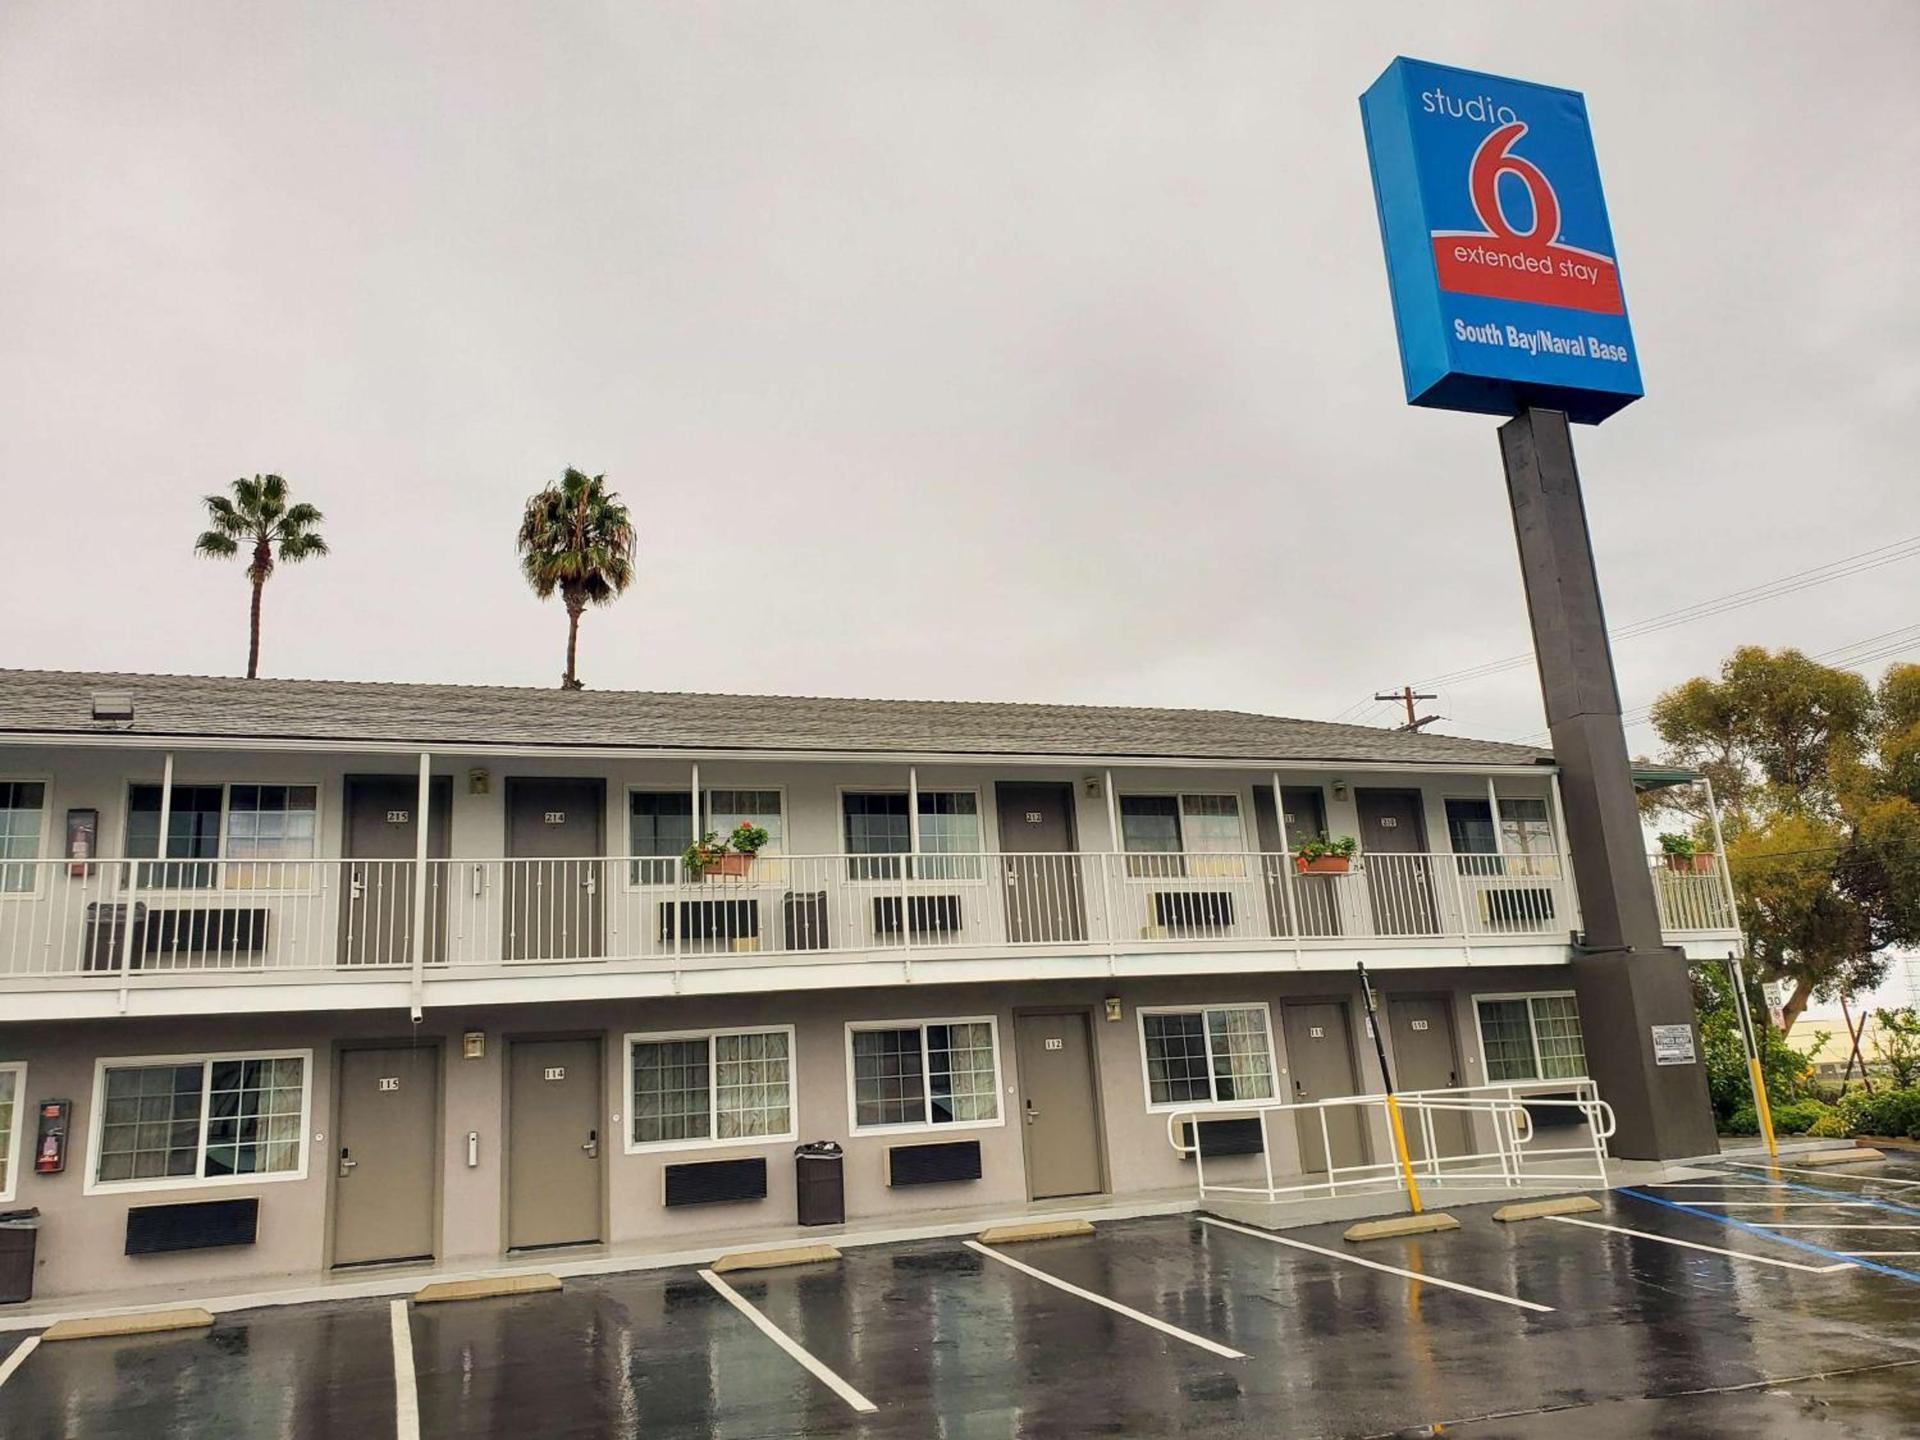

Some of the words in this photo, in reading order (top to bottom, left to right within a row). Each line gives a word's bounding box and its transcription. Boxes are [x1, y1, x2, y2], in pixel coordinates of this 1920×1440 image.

[1422, 88, 1517, 126] studio
[1468, 121, 1561, 244] 6
[1454, 245, 1553, 274] extended
[1559, 259, 1598, 285] stay
[1454, 318, 1504, 347] South
[1505, 325, 1586, 356] Bay/Naval
[1588, 337, 1628, 362] Base
[388, 811, 408, 822] 215
[545, 812, 565, 823] 214
[1767, 996, 1781, 1007] 30
[1046, 1039, 1062, 1049] 112
[545, 1068, 564, 1079] 114
[380, 1078, 399, 1090] 115
